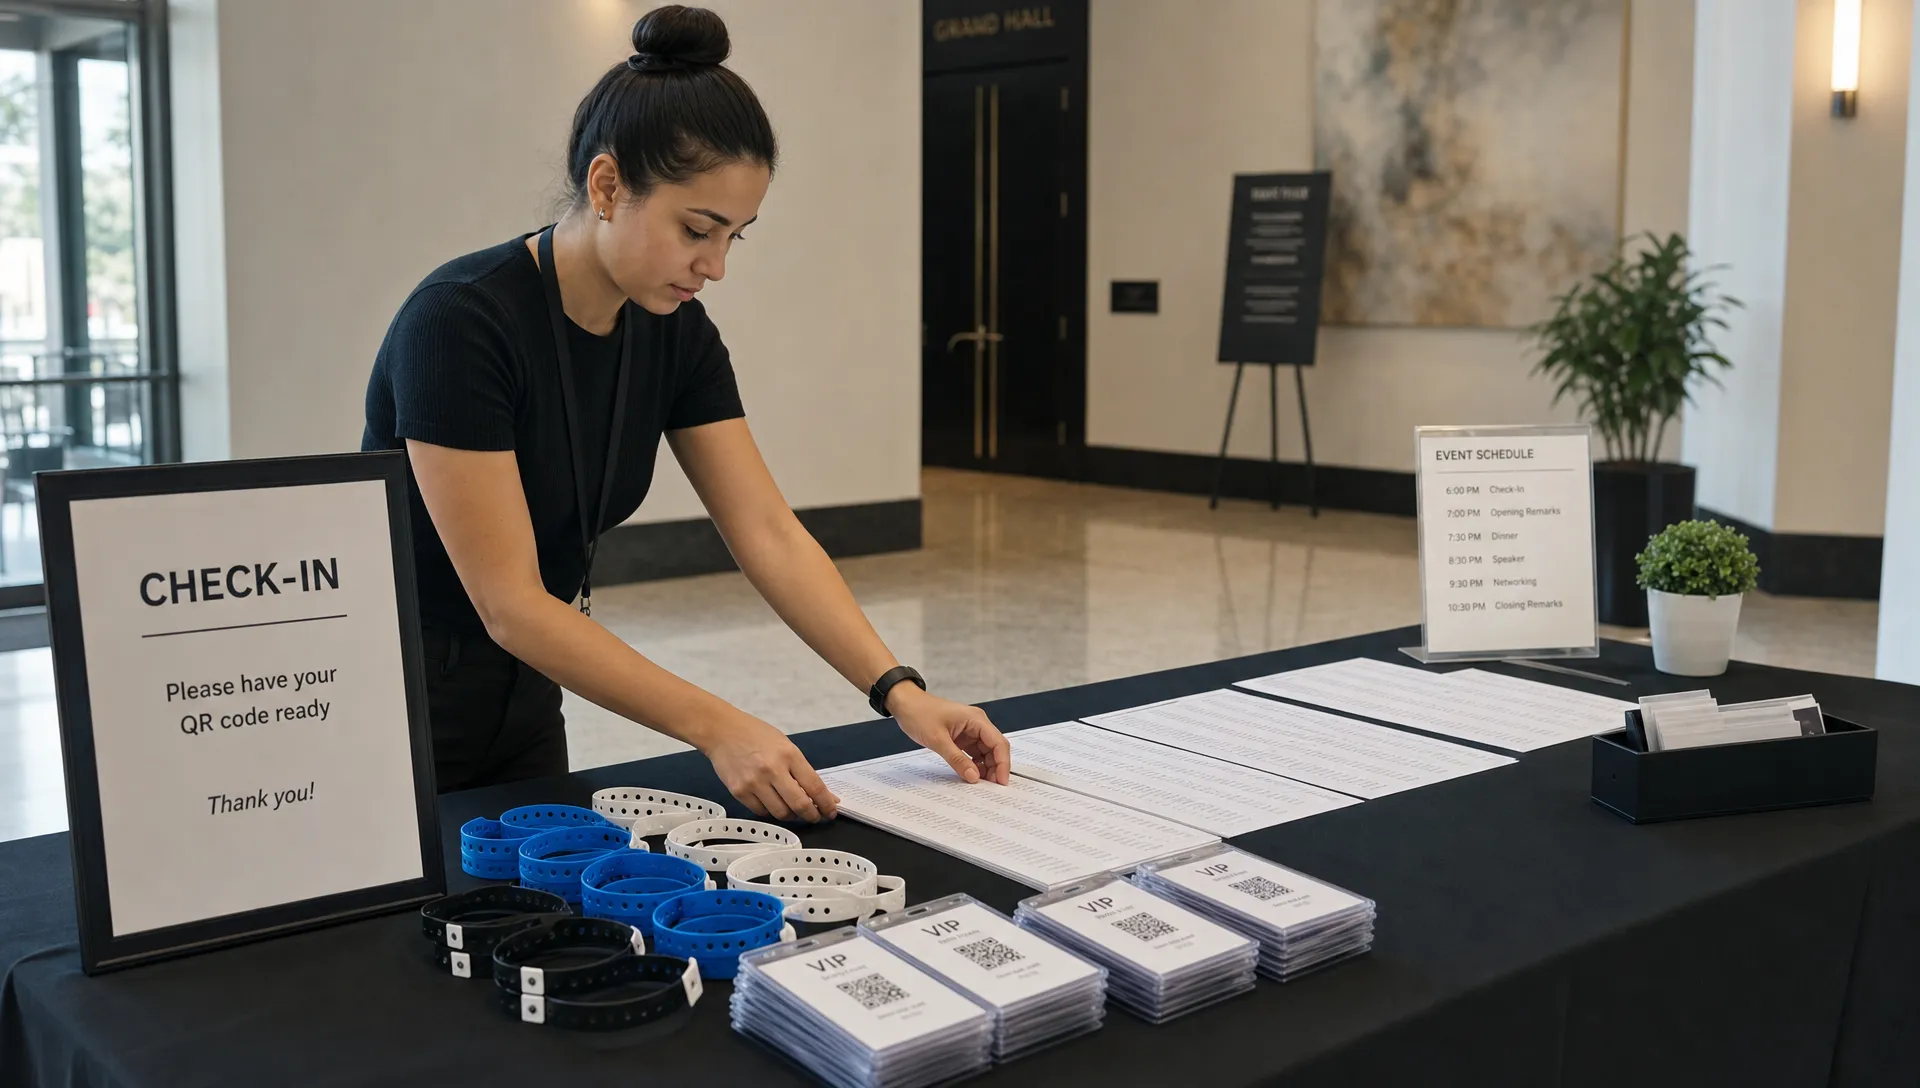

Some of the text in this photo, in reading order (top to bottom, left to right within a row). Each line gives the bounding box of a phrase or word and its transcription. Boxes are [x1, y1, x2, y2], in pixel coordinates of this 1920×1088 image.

[933, 6, 1055, 42] GRAND HALL
[1436, 449, 1534, 461] EVENT SCHEDULE
[1446, 485, 1524, 495] 6:00 PM Check-In
[1447, 507, 1560, 518] 7:00 PM Opening Remarks
[1448, 532, 1518, 542] 7:30 PM Dinner
[1449, 555, 1524, 565] 8:30 PM Speaker
[139, 557, 340, 607] CHECK-IN
[1450, 578, 1537, 588] 9:30 PM Networking
[1448, 600, 1563, 612] 10:30 PM Closing Remarks
[166, 667, 338, 702] Please have your
[180, 699, 330, 736] QR code ready
[207, 782, 315, 816] Thank you!
[1195, 863, 1228, 876] VIP
[1078, 897, 1114, 913] VIP
[921, 920, 960, 937] VIP
[806, 954, 847, 972] VIP
